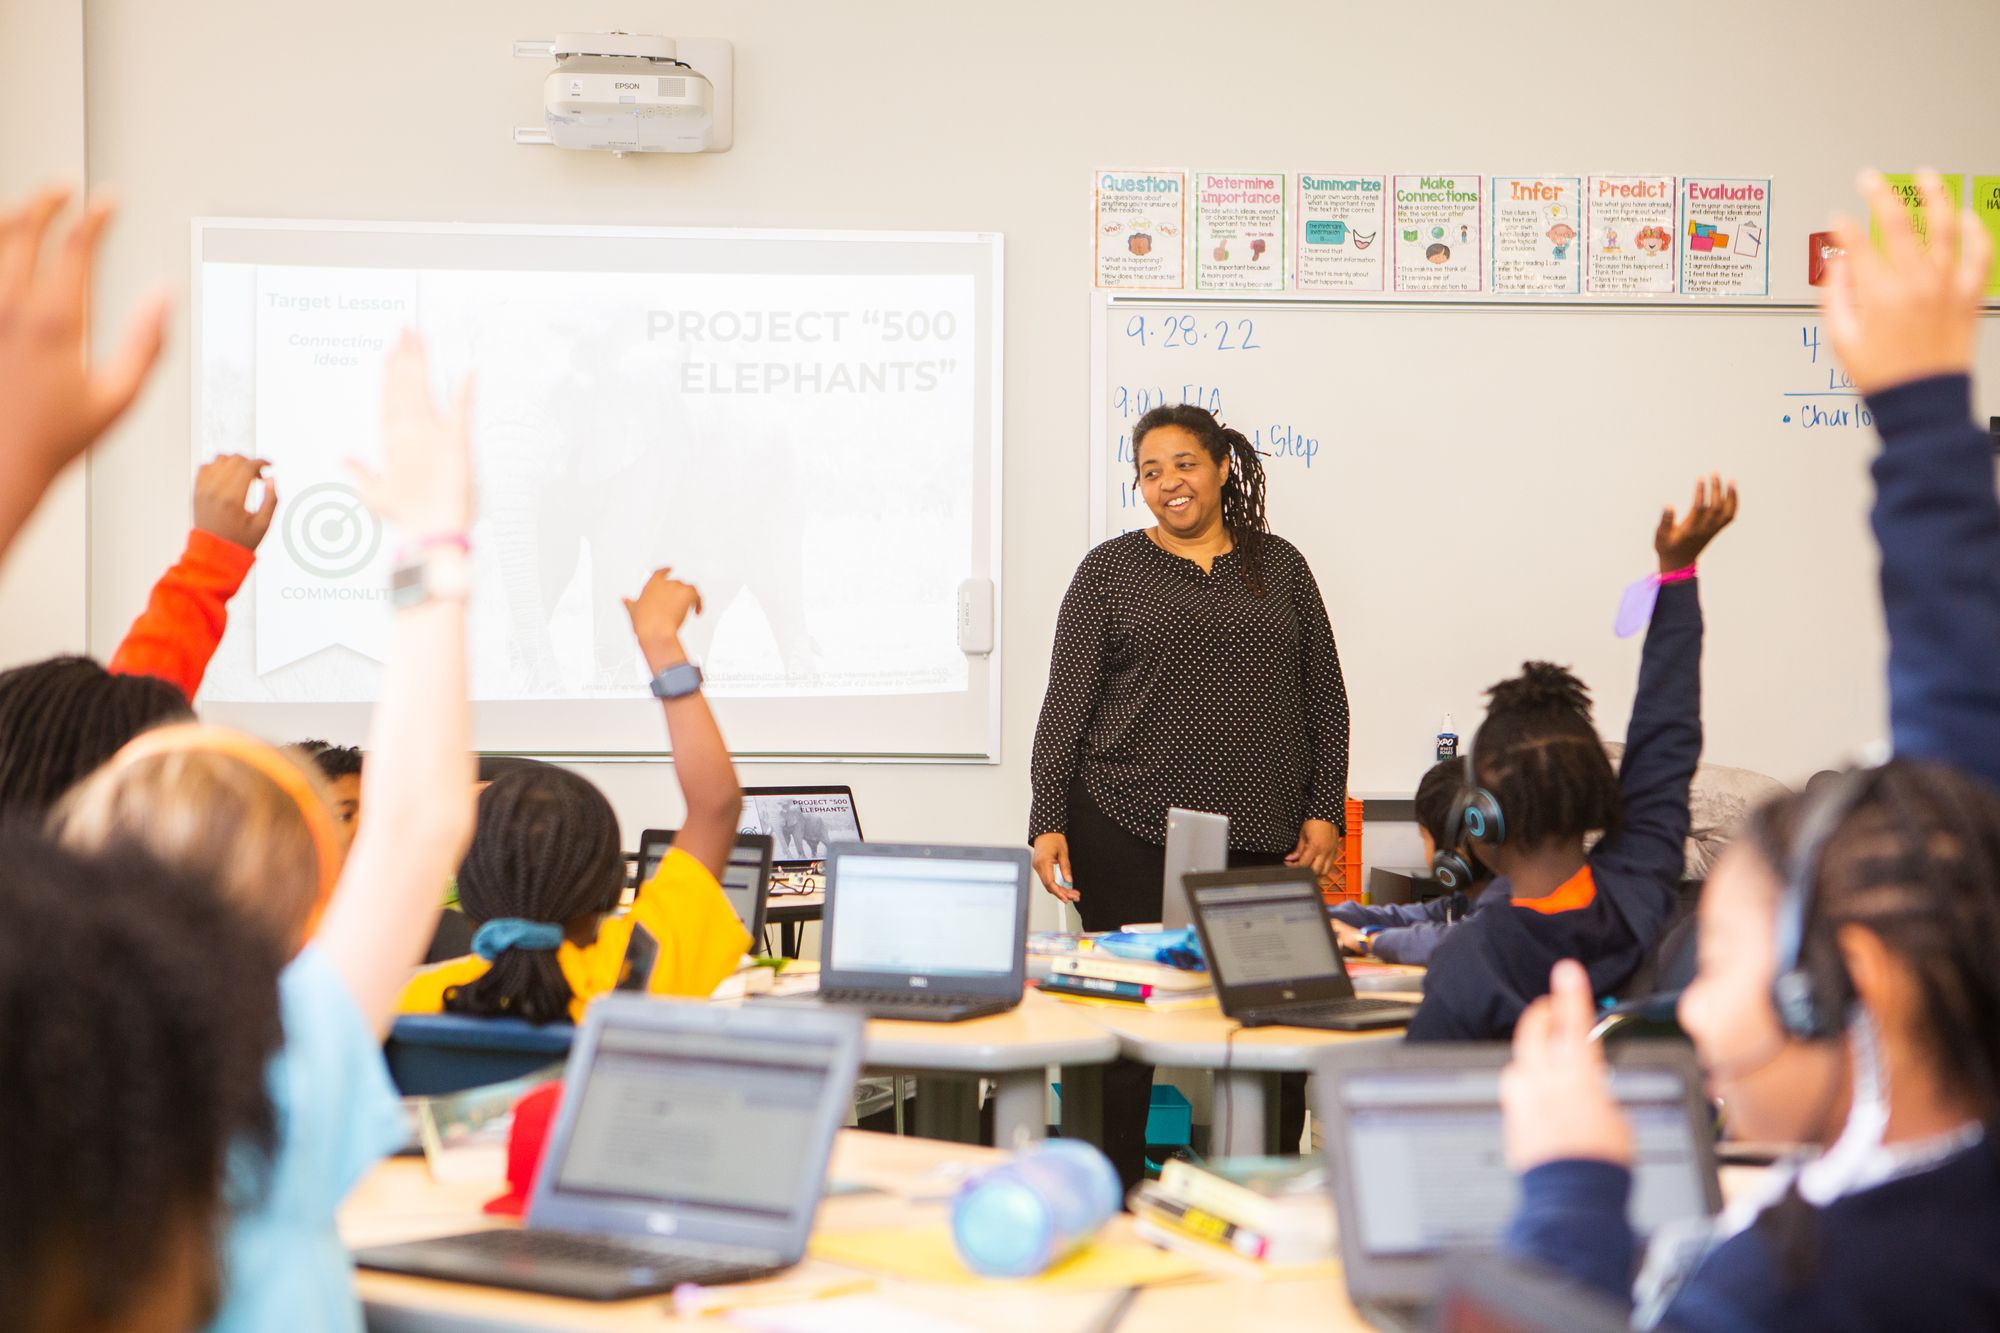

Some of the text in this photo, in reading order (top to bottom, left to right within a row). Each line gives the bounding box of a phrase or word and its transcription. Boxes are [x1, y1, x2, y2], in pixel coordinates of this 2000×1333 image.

[615, 82, 640, 90] EPSON
[1101, 175, 1179, 192] Question
[1207, 175, 1275, 190] Determine
[1302, 176, 1381, 191] Summarize
[1420, 176, 1455, 190] Make
[1511, 181, 1564, 201] Infer
[1599, 180, 1666, 198] Predict
[1201, 190, 1281, 207] Importance
[1396, 189, 1478, 202] Connections
[1689, 183, 1764, 201] Evaluate
[267, 292, 406, 312] Target Lesson
[646, 309, 850, 343] PROJECT
[288, 333, 384, 351] Connecting
[1802, 326, 1822, 364] 4
[312, 353, 360, 367] Ideas
[1270, 424, 1319, 469] Step
